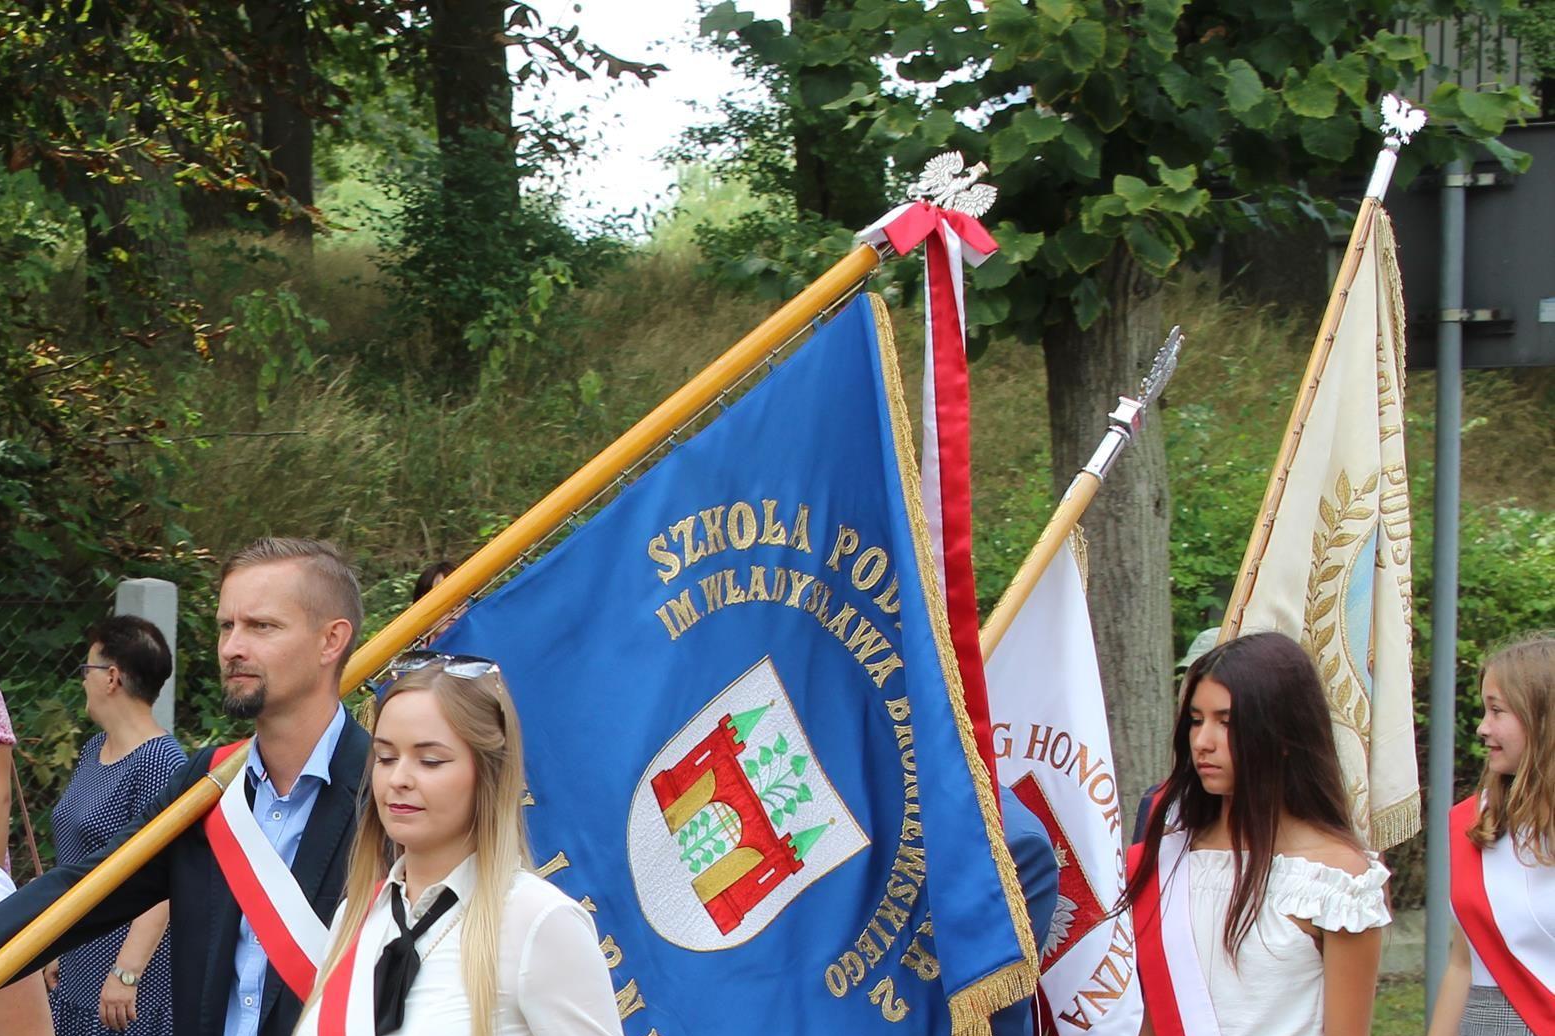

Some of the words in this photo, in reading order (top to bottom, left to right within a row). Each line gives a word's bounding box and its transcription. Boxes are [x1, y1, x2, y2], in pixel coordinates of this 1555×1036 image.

[648, 499, 812, 585] SZKOŁA
[867, 975, 909, 1023] 2
[1024, 722, 1124, 838] HONOR
